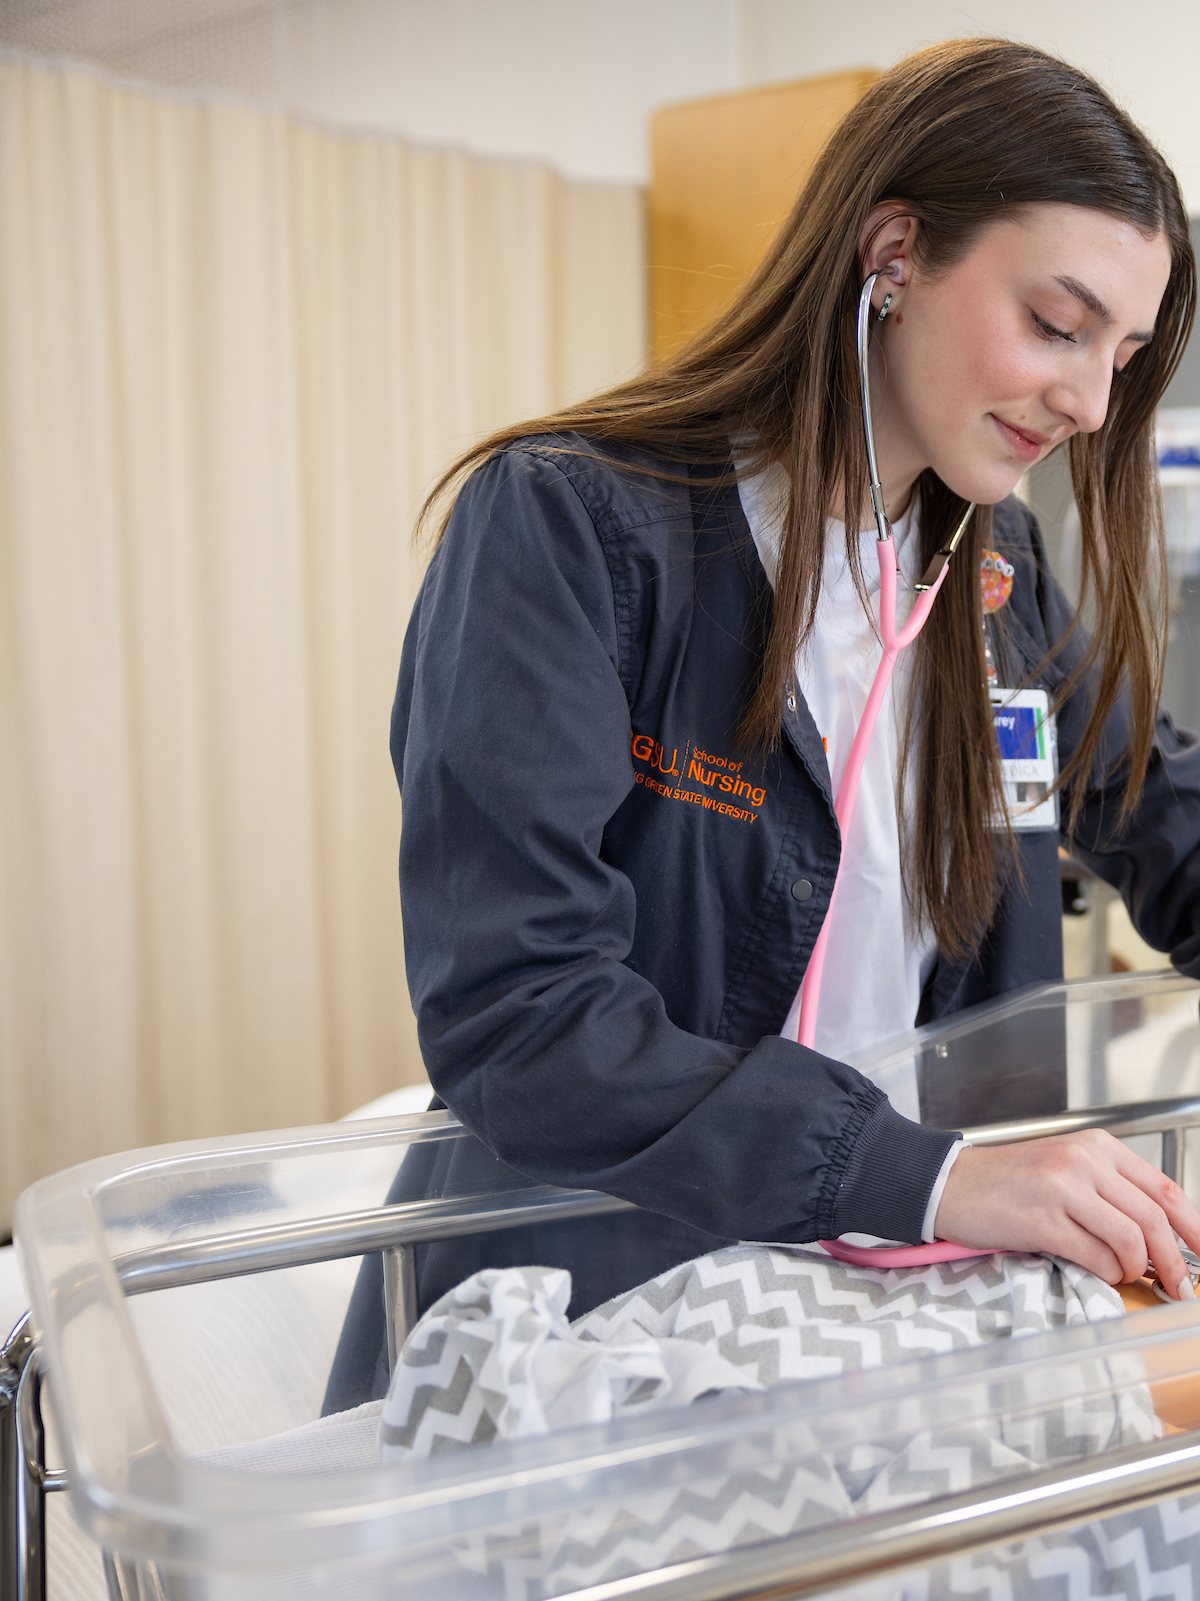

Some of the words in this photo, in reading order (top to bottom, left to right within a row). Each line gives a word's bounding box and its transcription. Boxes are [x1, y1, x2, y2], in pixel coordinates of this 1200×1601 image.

[992, 715, 1016, 730] rey
[693, 746, 728, 768] School
[728, 761, 743, 773] of
[687, 759, 767, 807] Nursing
[673, 788, 703, 805] STATE
[701, 796, 759, 824] NIVERSITY
